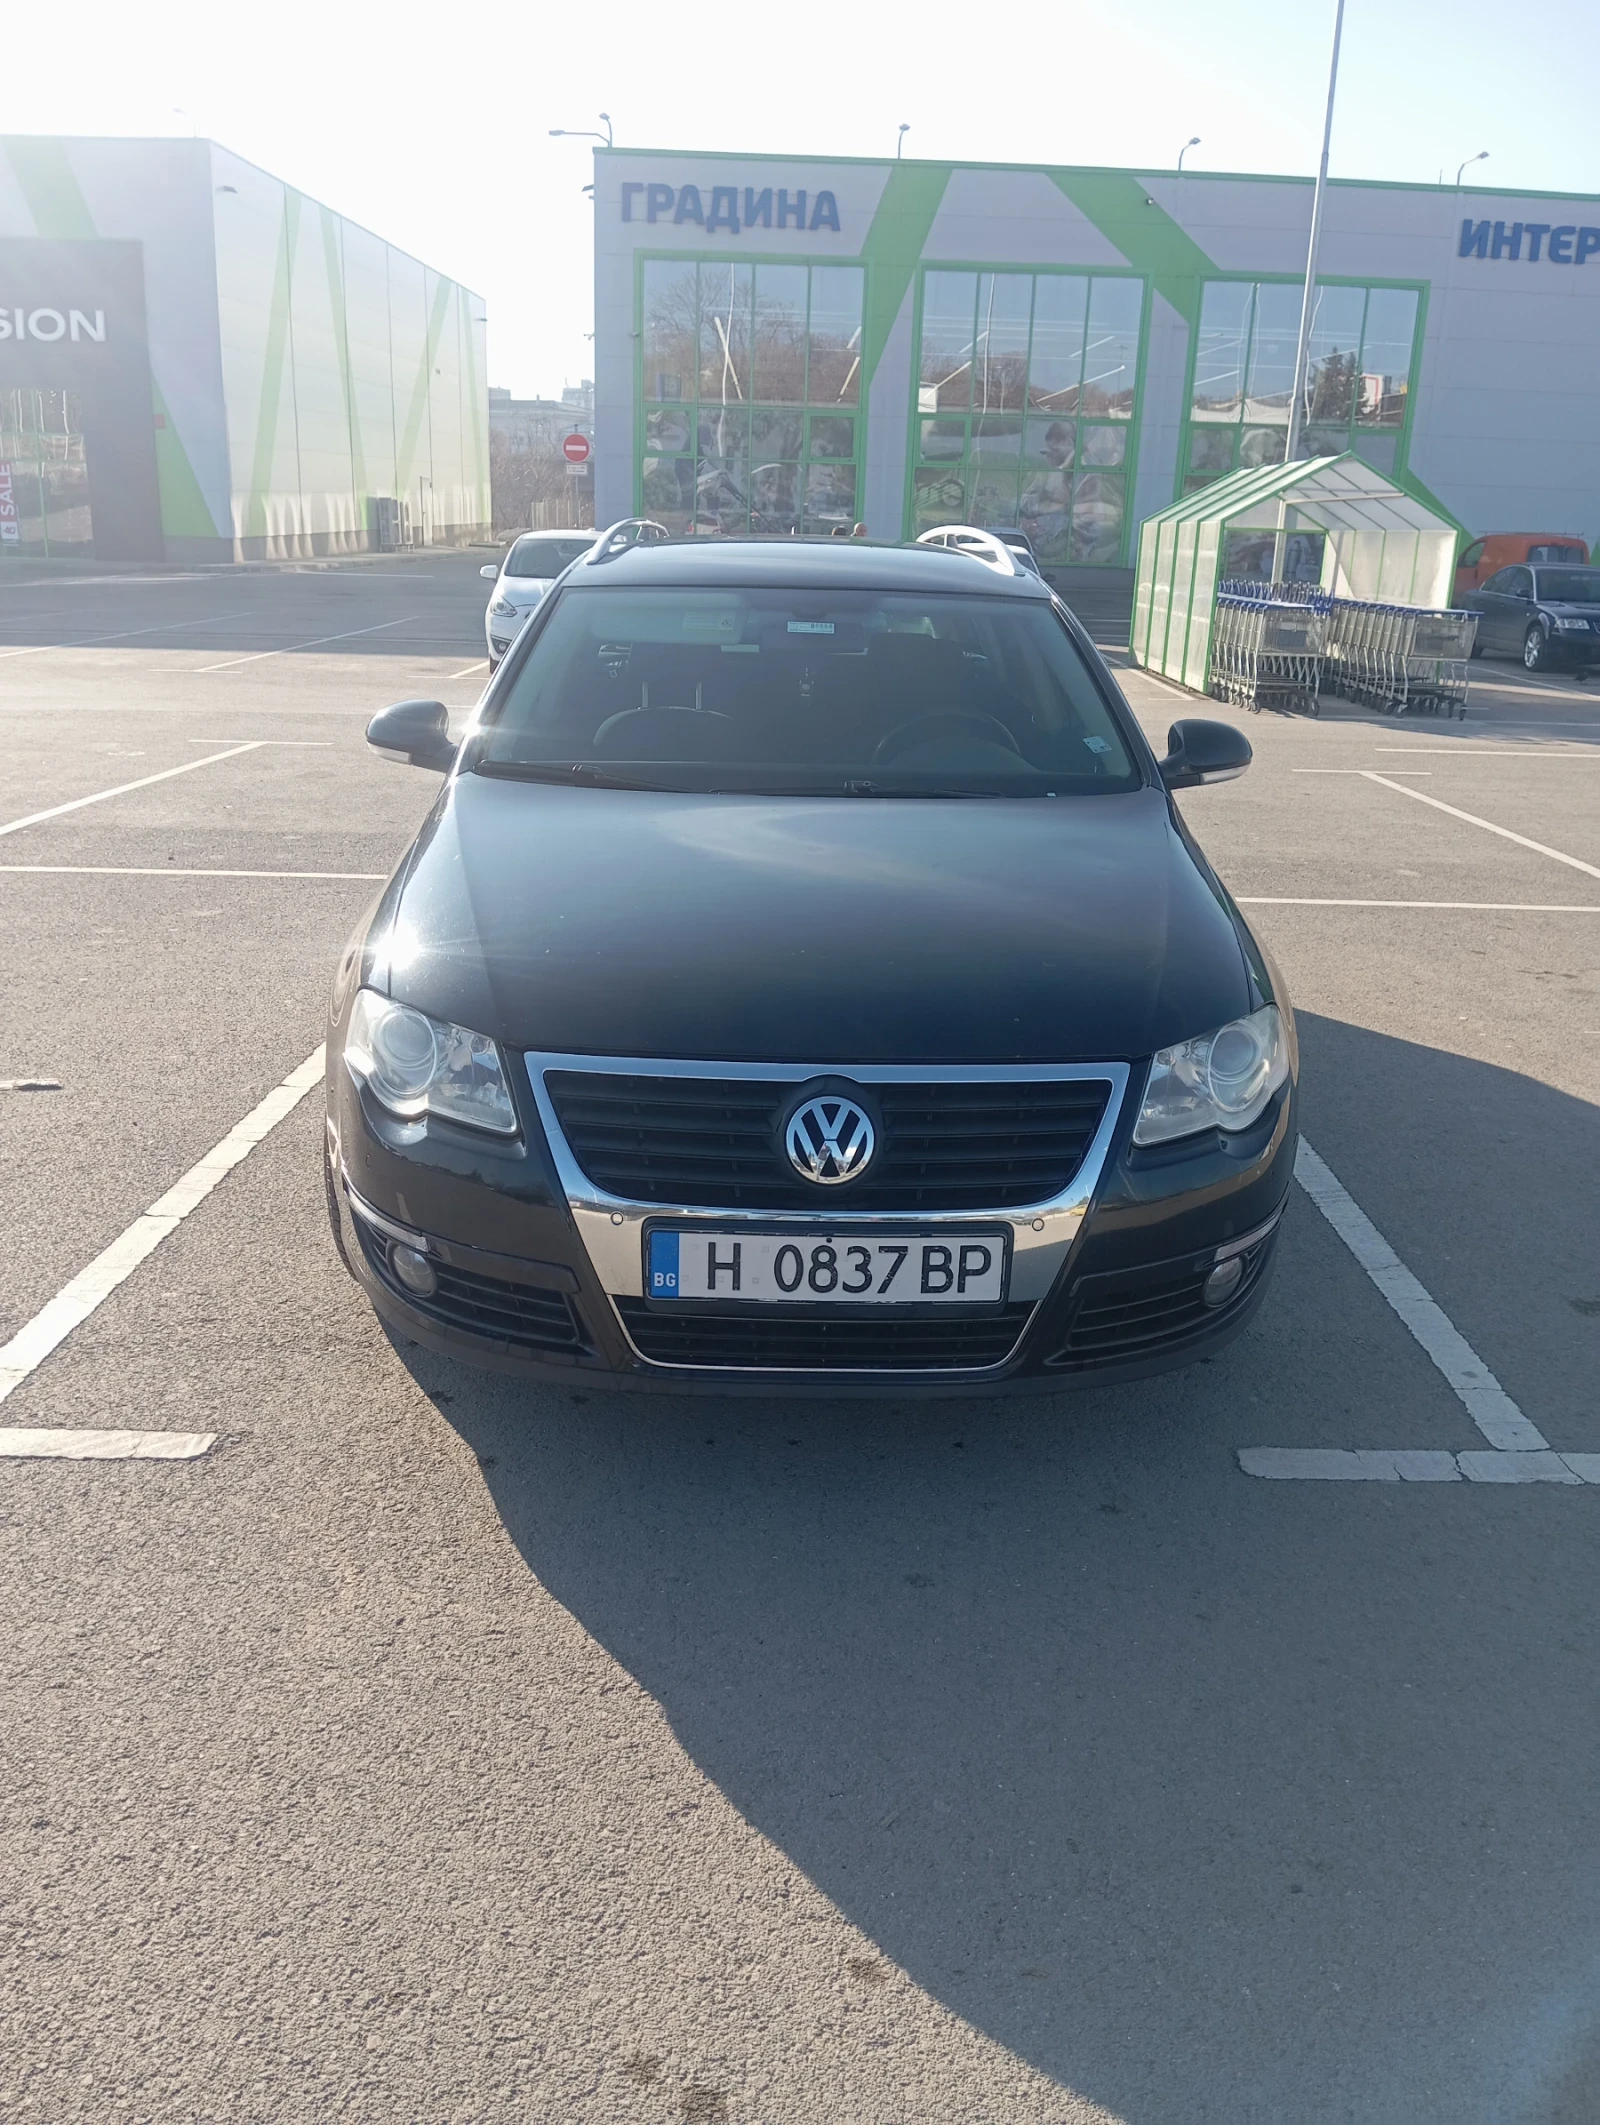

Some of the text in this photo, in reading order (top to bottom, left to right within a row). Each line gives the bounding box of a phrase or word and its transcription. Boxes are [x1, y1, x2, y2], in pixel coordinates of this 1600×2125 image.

[621, 182, 841, 235] ГРАДИНА
[0, 463, 15, 516] SALE
[653, 1272, 677, 1287] BG
[773, 1244, 909, 1294] 0837
